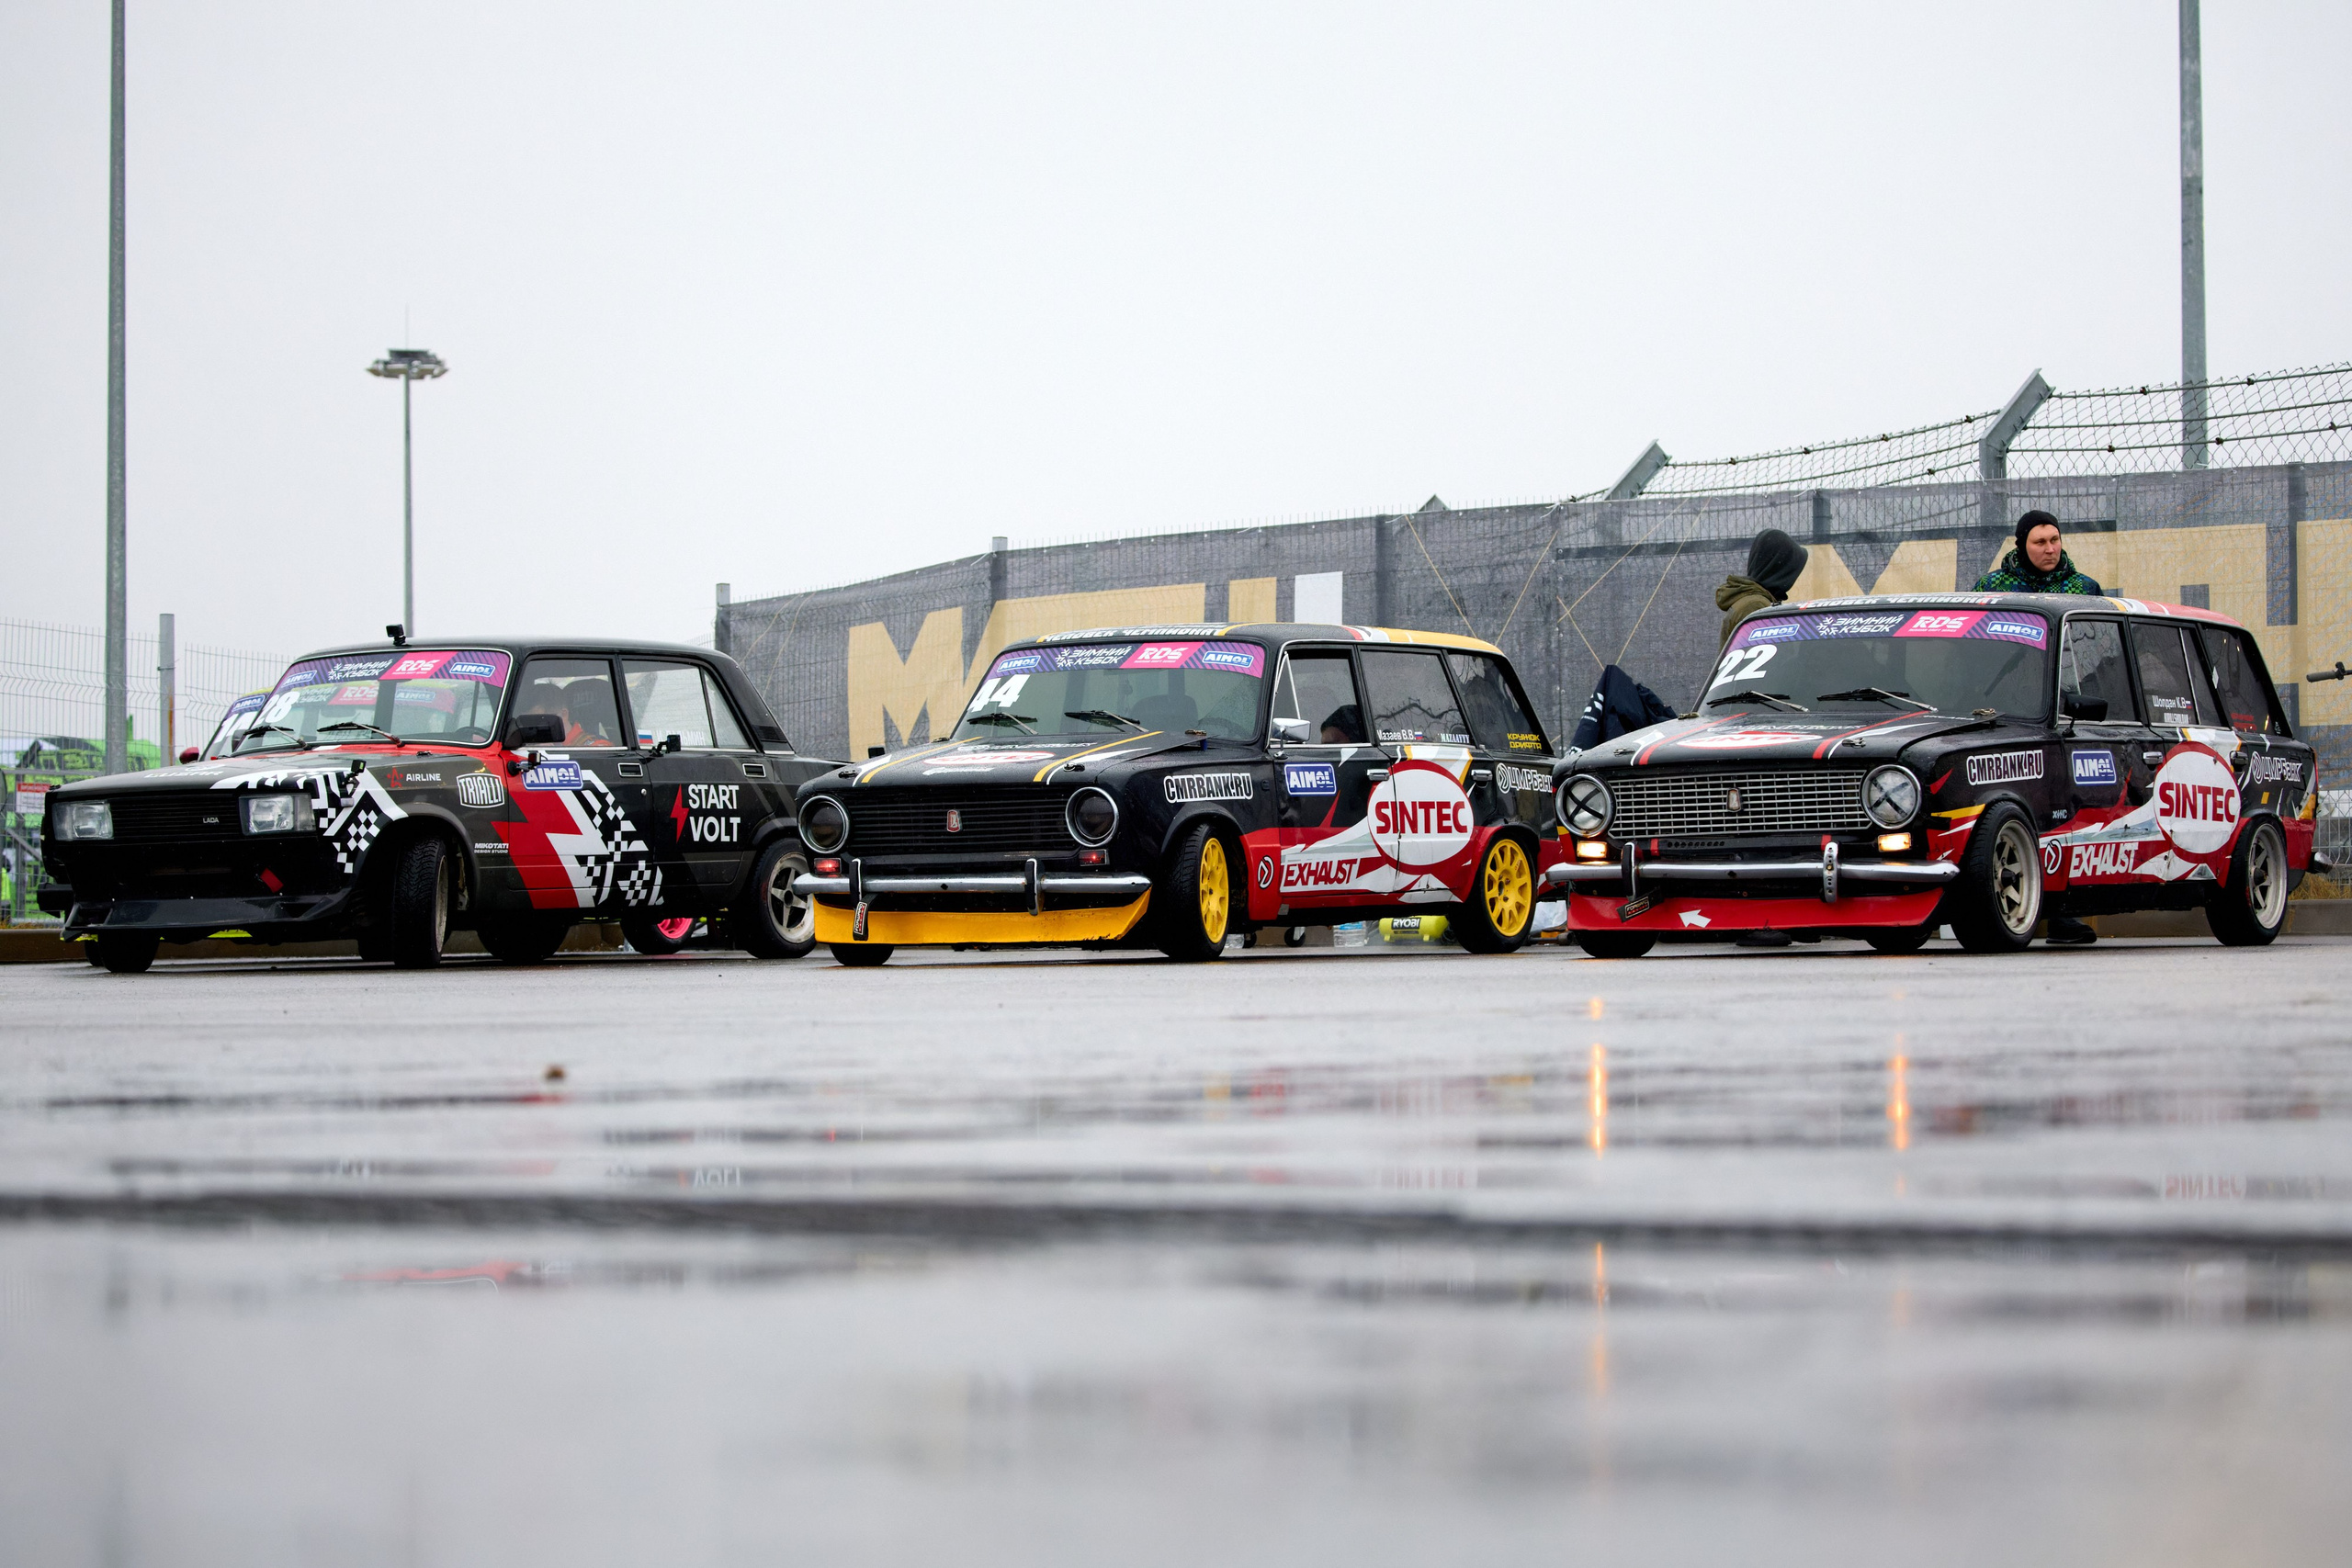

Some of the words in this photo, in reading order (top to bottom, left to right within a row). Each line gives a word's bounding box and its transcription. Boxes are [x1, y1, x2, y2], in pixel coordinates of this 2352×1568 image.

[1833, 615, 1905, 626] ЗИМНИЙ
[1912, 615, 1970, 628] RDS
[1751, 626, 1796, 638] AIMOL
[1838, 624, 1896, 634] КУБОК
[1989, 624, 2041, 637] AIMOL
[1072, 645, 1133, 658] ЗИМНИЙ
[1137, 647, 1189, 660] RDS
[342, 659, 394, 671] ЗИМНИЙ
[1000, 658, 1036, 670] AIMOL
[1074, 656, 1124, 666] КУБОК
[1204, 653, 1251, 664] AIMOL
[396, 660, 440, 671] RDS
[451, 664, 492, 675] AIMOL
[1709, 644, 1778, 692] 22
[283, 671, 314, 685] AIMOL
[342, 669, 384, 678] КУБОК
[967, 674, 1030, 712] 44
[1507, 733, 1540, 741] КРУЖОК
[1967, 750, 2043, 784] CMRBANK.RU
[2075, 758, 2114, 777] AIMOL
[2262, 756, 2303, 783] ЦМРБанк
[405, 773, 441, 782] AIRLINE
[526, 766, 581, 784] AIMOL
[1289, 771, 1334, 788] AIMOL
[1508, 766, 1553, 794] ЦМРБан
[459, 776, 504, 806] TRIALLI
[1165, 773, 1253, 802] CMRBANK.RU
[688, 784, 740, 809] START
[2159, 782, 2235, 823] SINTEC
[1374, 801, 1469, 834] SINTEC
[689, 816, 741, 842] VOLT
[2069, 841, 2139, 878] EXHAUST
[1283, 858, 1358, 887] EXHAUST
[1393, 918, 1419, 928] RYOBI
